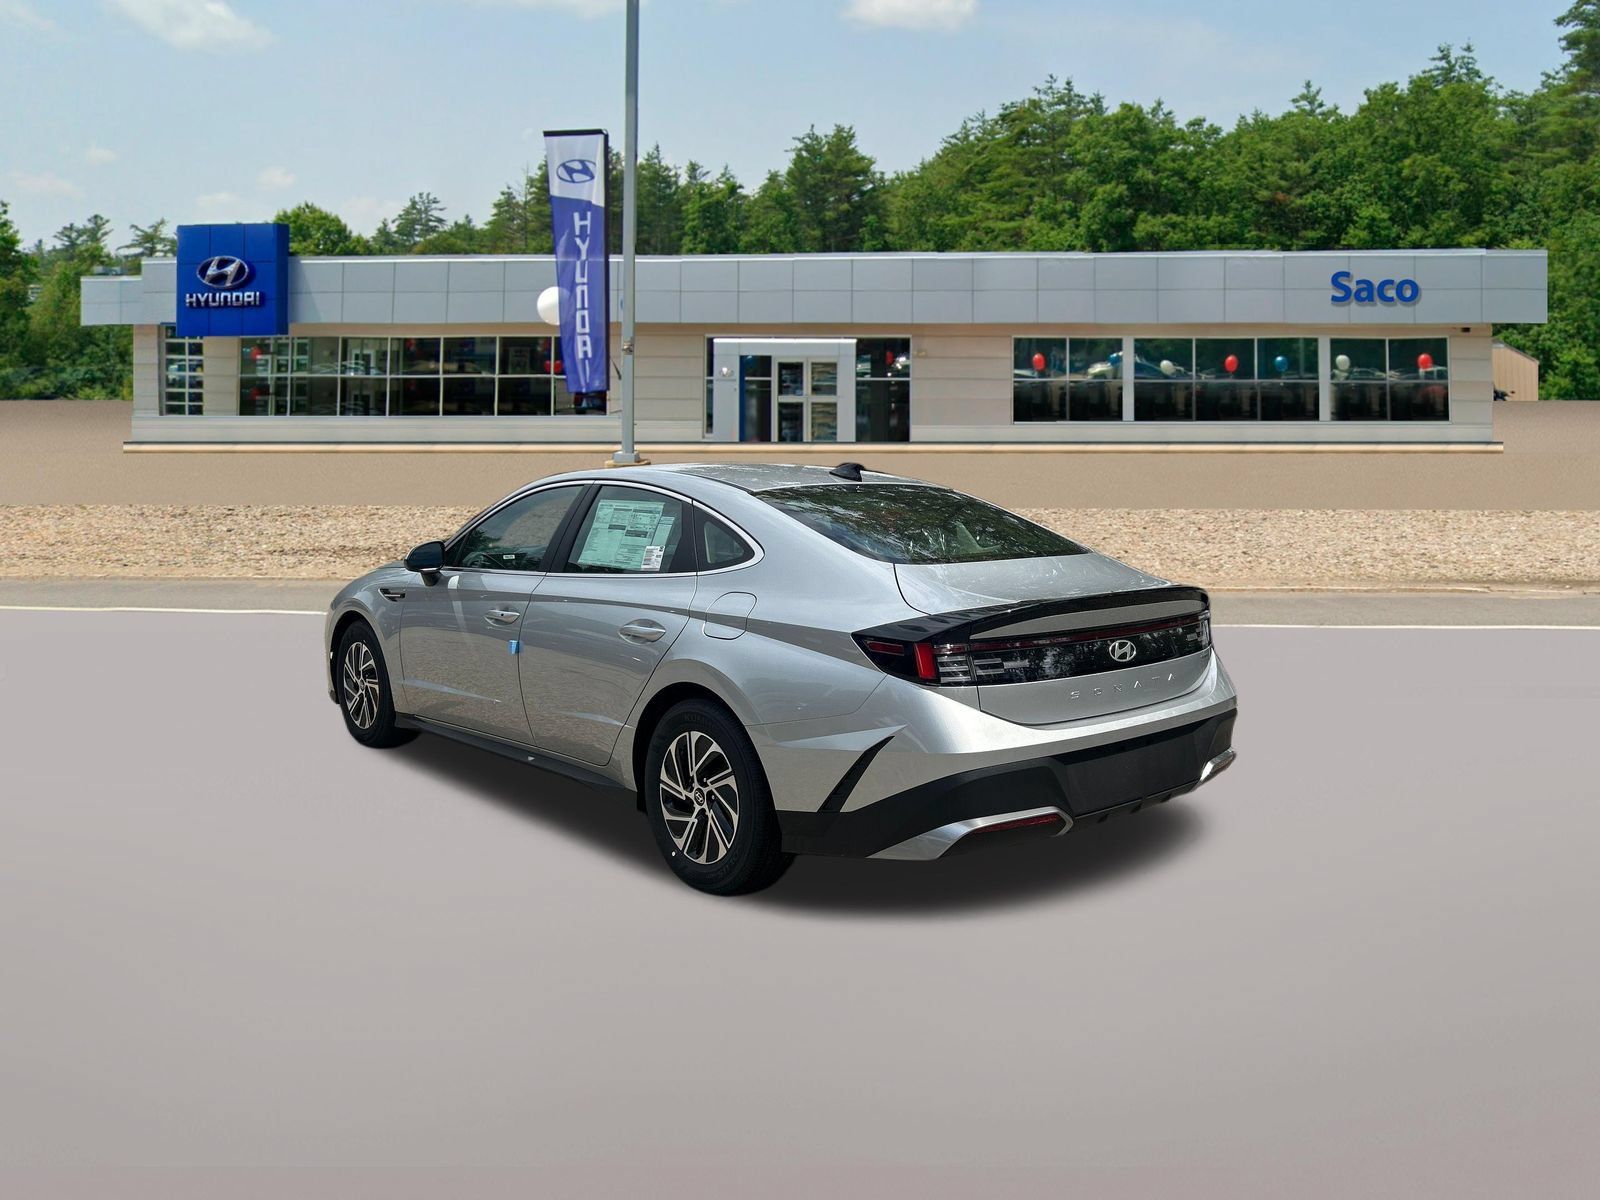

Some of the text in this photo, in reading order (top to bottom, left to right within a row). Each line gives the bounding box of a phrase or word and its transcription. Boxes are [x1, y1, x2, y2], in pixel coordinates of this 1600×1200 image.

[185, 291, 260, 307] HYUNDAI
[573, 211, 592, 383] HYUNDAI
[1330, 271, 1420, 303] Saco
[1070, 673, 1177, 700] SONATA
